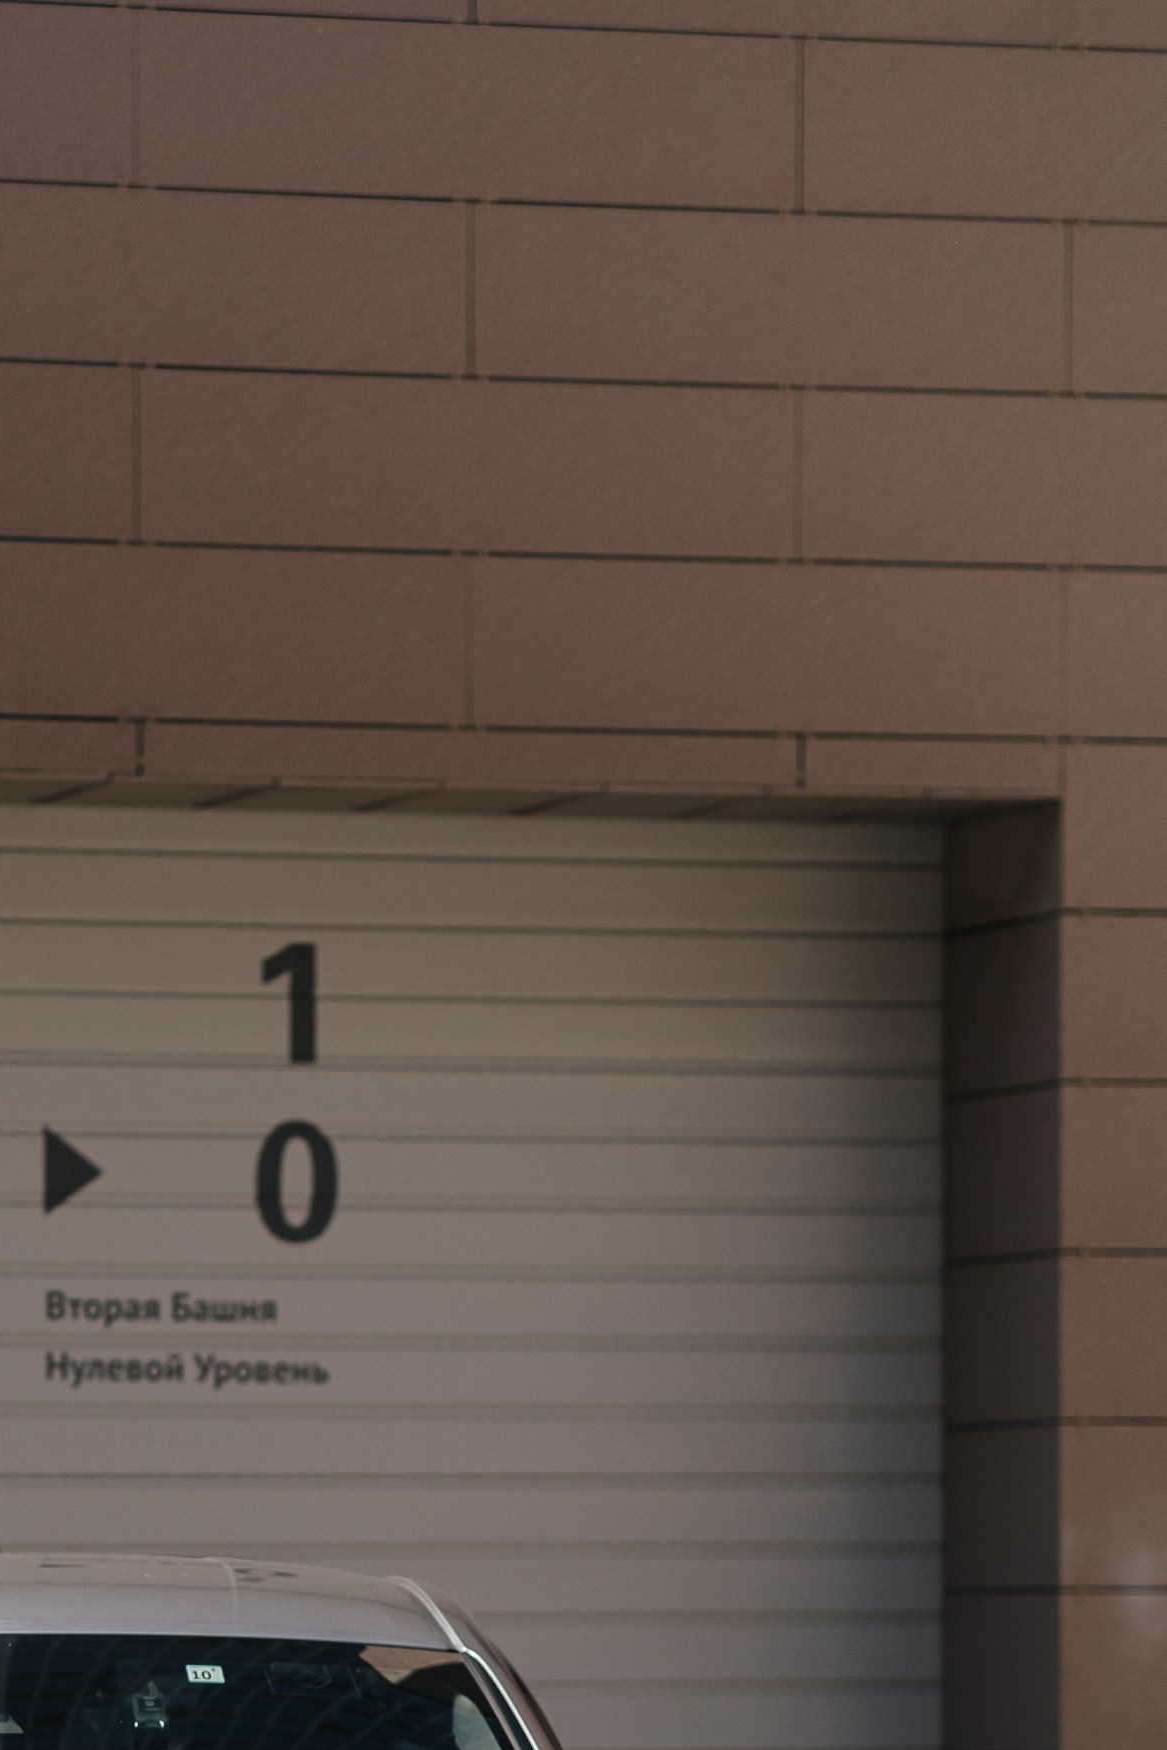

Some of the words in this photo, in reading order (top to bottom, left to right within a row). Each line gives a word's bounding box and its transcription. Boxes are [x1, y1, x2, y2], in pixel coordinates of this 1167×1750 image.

[262, 943, 317, 1064] 1
[256, 1120, 339, 1243] 0
[45, 1289, 160, 1328] Вторая
[171, 1292, 277, 1322] Башня
[45, 1350, 184, 1388] Нулевой
[194, 1354, 329, 1391] Уровень
